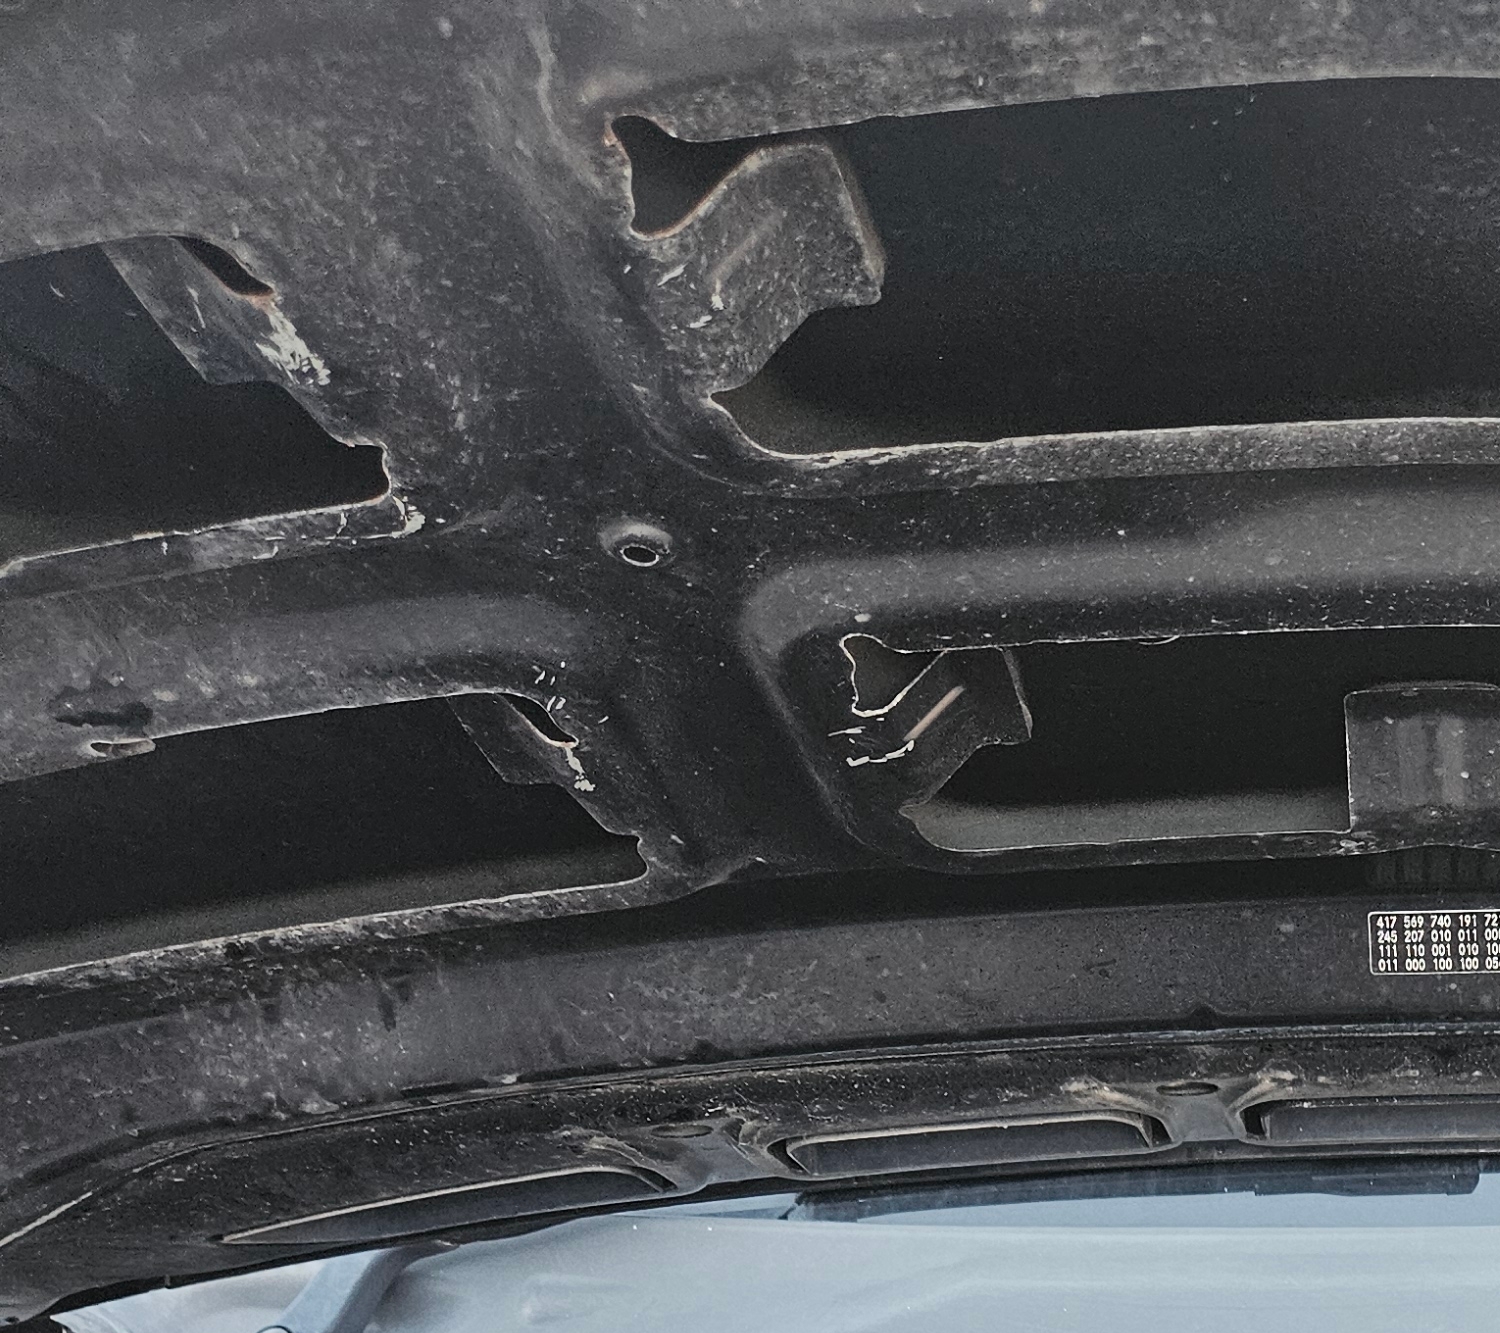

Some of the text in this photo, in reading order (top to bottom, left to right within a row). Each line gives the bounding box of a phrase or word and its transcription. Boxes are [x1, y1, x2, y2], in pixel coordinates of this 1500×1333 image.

[1376, 916, 1397, 928] 417
[1404, 916, 1424, 928] 569
[1431, 915, 1451, 928] 740
[1459, 915, 1477, 927] 191
[1378, 931, 1397, 943] 245
[1405, 930, 1424, 942] 207
[1431, 930, 1451, 942] 010
[1458, 929, 1477, 941] 011
[1379, 945, 1397, 957] 111
[1406, 944, 1425, 956] 110
[1432, 944, 1451, 956] 001
[1459, 943, 1478, 955] 010
[1378, 959, 1397, 971] 011
[1406, 958, 1425, 971] 000
[1433, 958, 1452, 970] 100
[1460, 958, 1478, 969] 100
